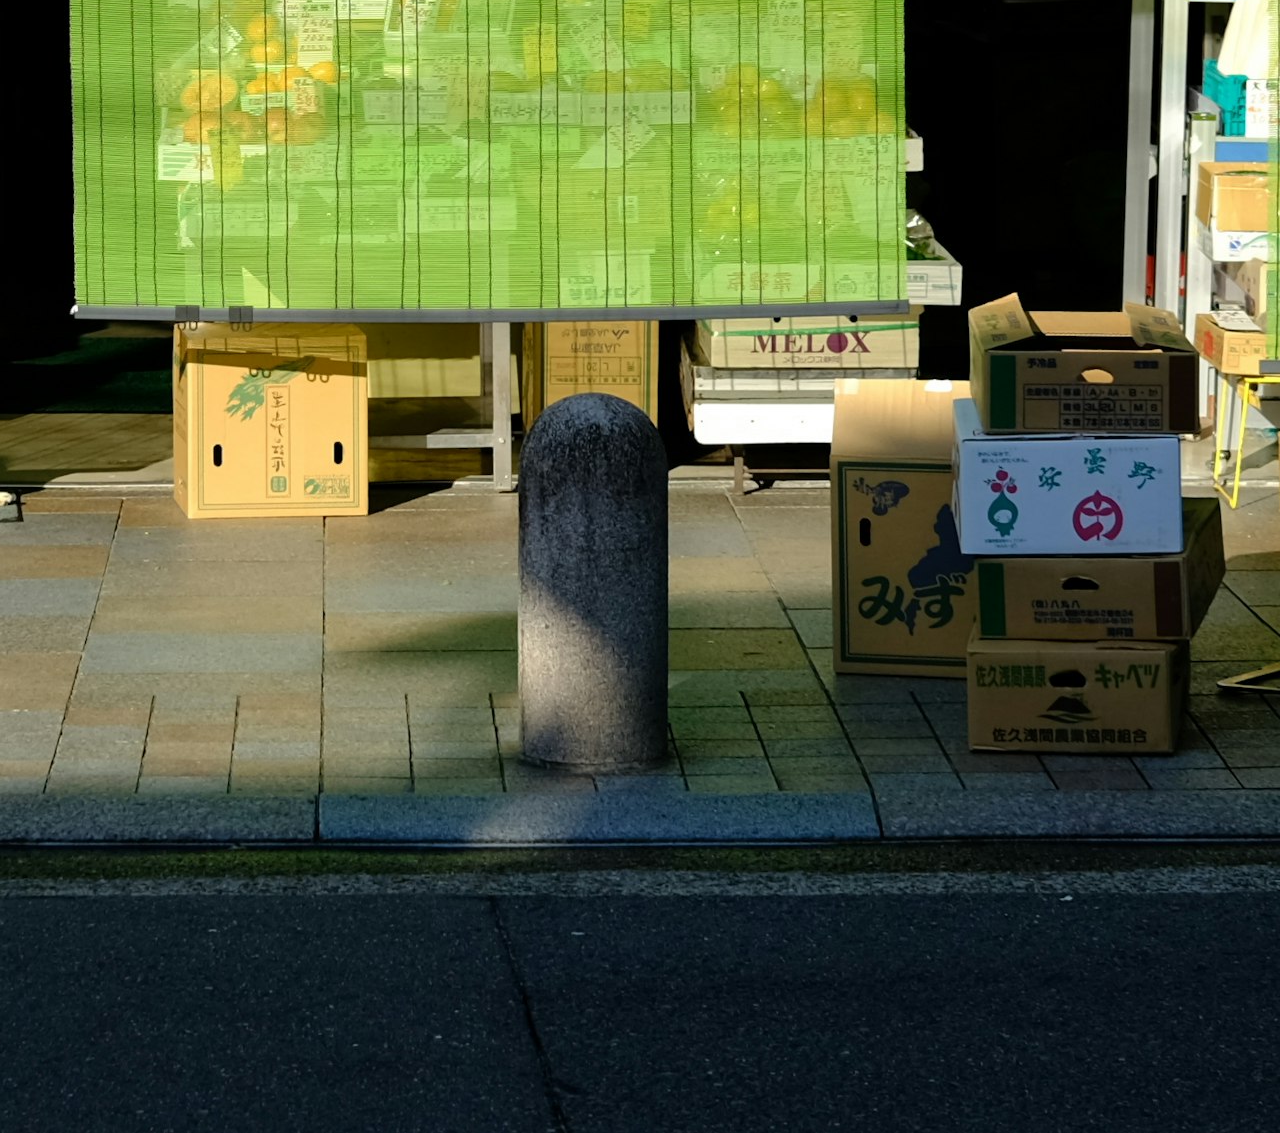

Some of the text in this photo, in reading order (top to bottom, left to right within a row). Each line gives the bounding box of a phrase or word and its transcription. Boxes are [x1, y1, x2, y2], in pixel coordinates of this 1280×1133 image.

[975, 663, 1161, 689] 佐久浅間高原 キャベツ
[992, 727, 1148, 744] 佐久浅間農業協同組合
